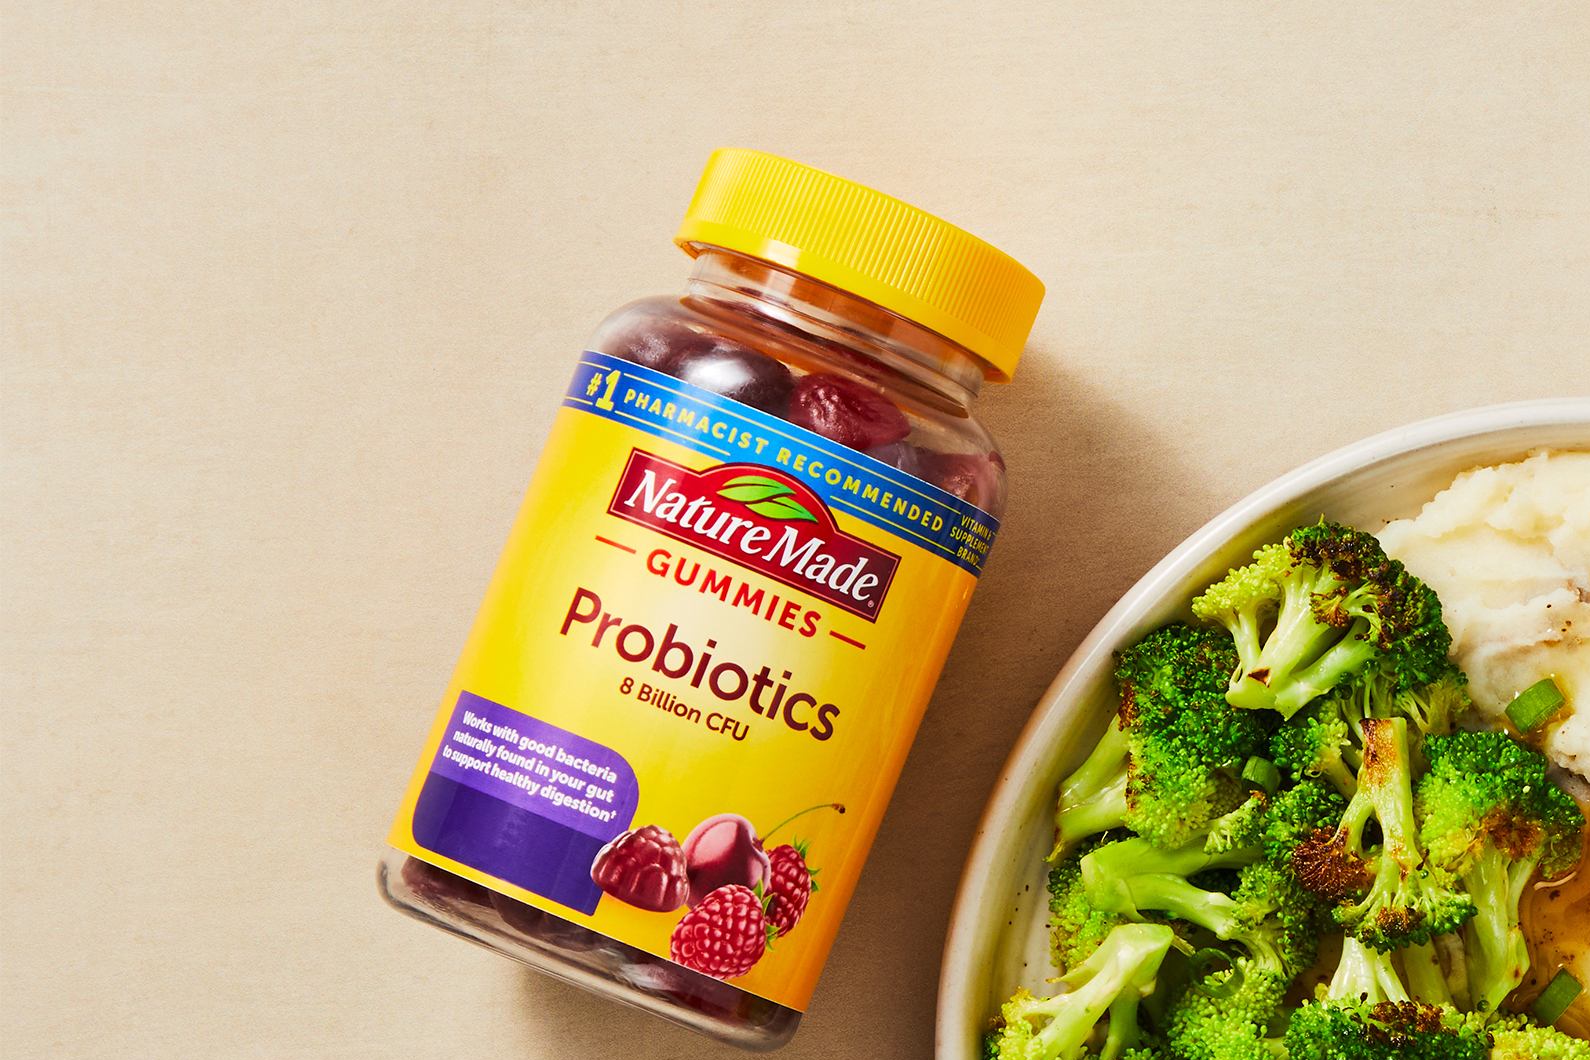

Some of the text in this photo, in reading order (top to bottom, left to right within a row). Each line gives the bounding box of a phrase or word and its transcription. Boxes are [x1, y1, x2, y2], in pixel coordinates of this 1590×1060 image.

[586, 369, 944, 532] #1 PHARMACIST RECOMMENDED
[961, 515, 989, 539] VITAMIN
[646, 548, 822, 638] GUMMIES
[559, 586, 840, 741] Probiotics
[619, 677, 750, 741] 8 Billion CFU
[442, 745, 452, 758] to
[451, 750, 492, 774] support
[491, 762, 540, 796] healthy
[453, 730, 614, 803] naturally found in your gut
[462, 710, 617, 783] Works with good bacteria
